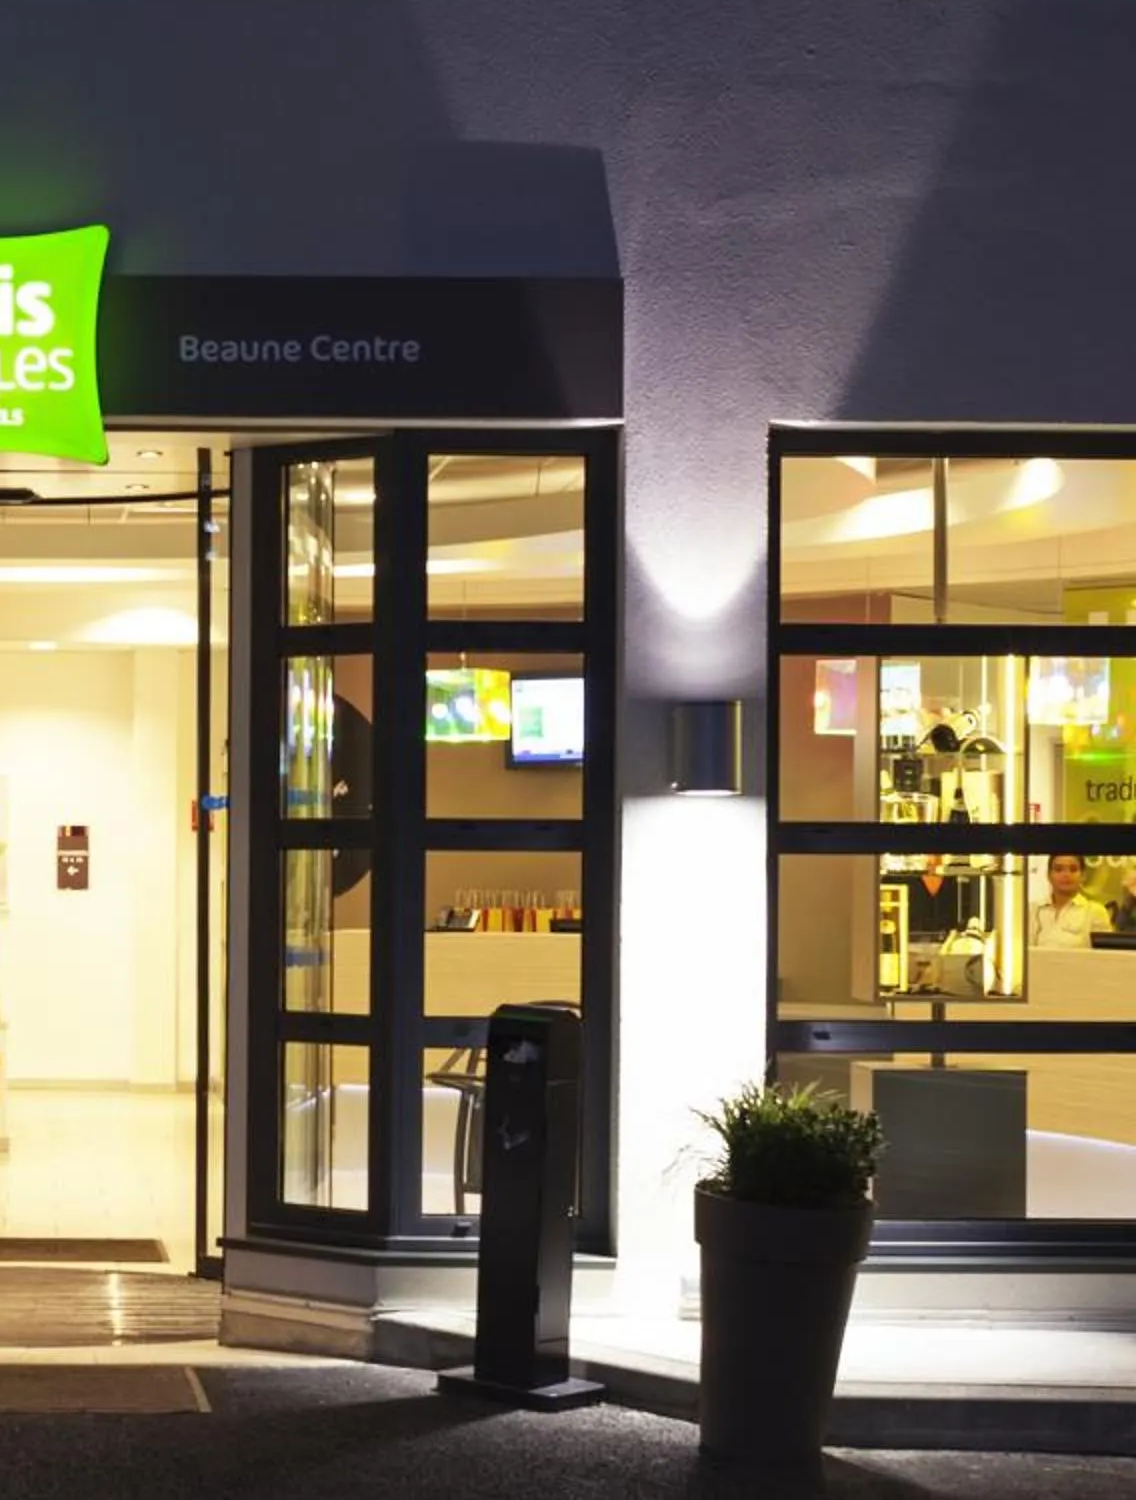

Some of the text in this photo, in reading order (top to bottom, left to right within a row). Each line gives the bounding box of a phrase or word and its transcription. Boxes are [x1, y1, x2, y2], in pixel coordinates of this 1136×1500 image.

[178, 335, 421, 362] Beaune Centre
[1086, 775, 1136, 802] trad
